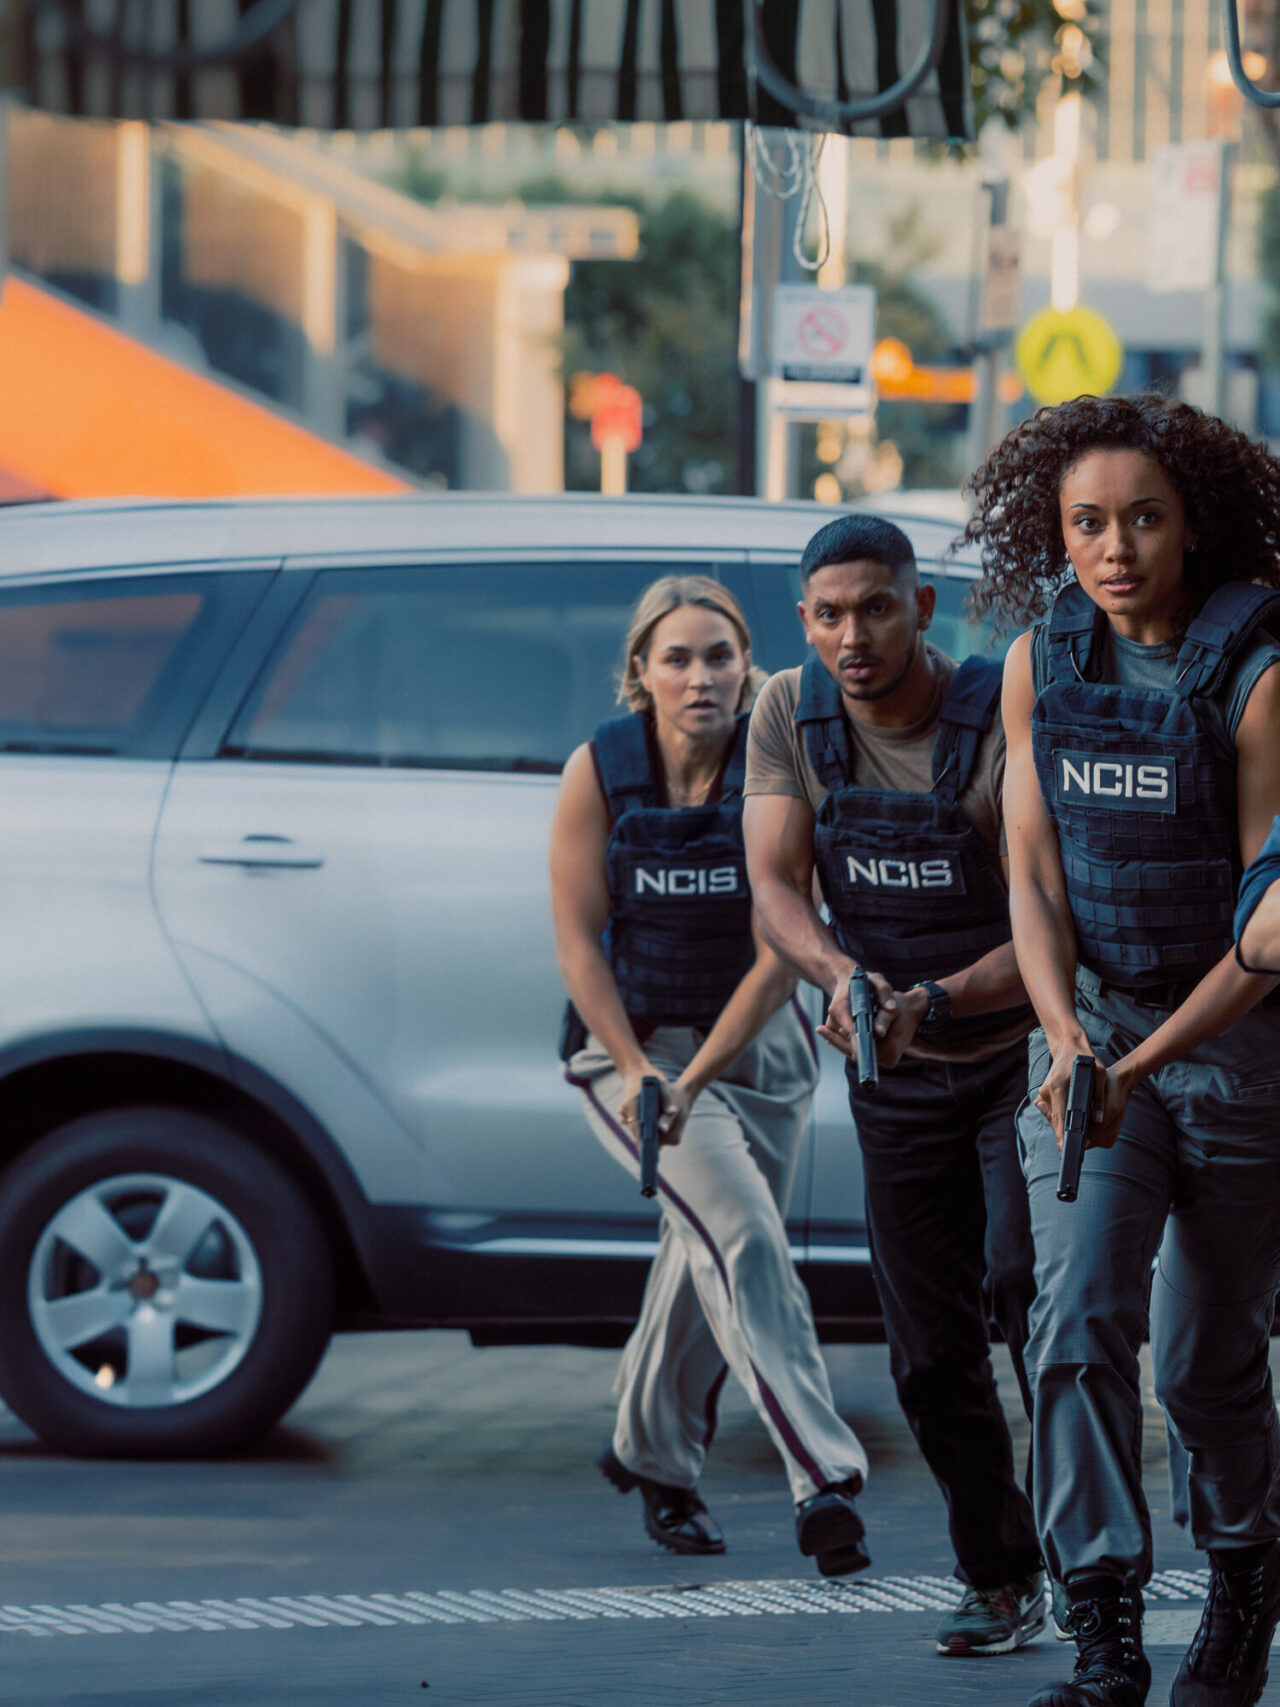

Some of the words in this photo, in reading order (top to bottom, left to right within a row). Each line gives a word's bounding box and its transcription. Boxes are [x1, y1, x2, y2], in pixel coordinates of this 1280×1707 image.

[1062, 758, 1168, 799] NCIS
[635, 866, 738, 895] NCIS
[846, 855, 953, 889] NCIS
